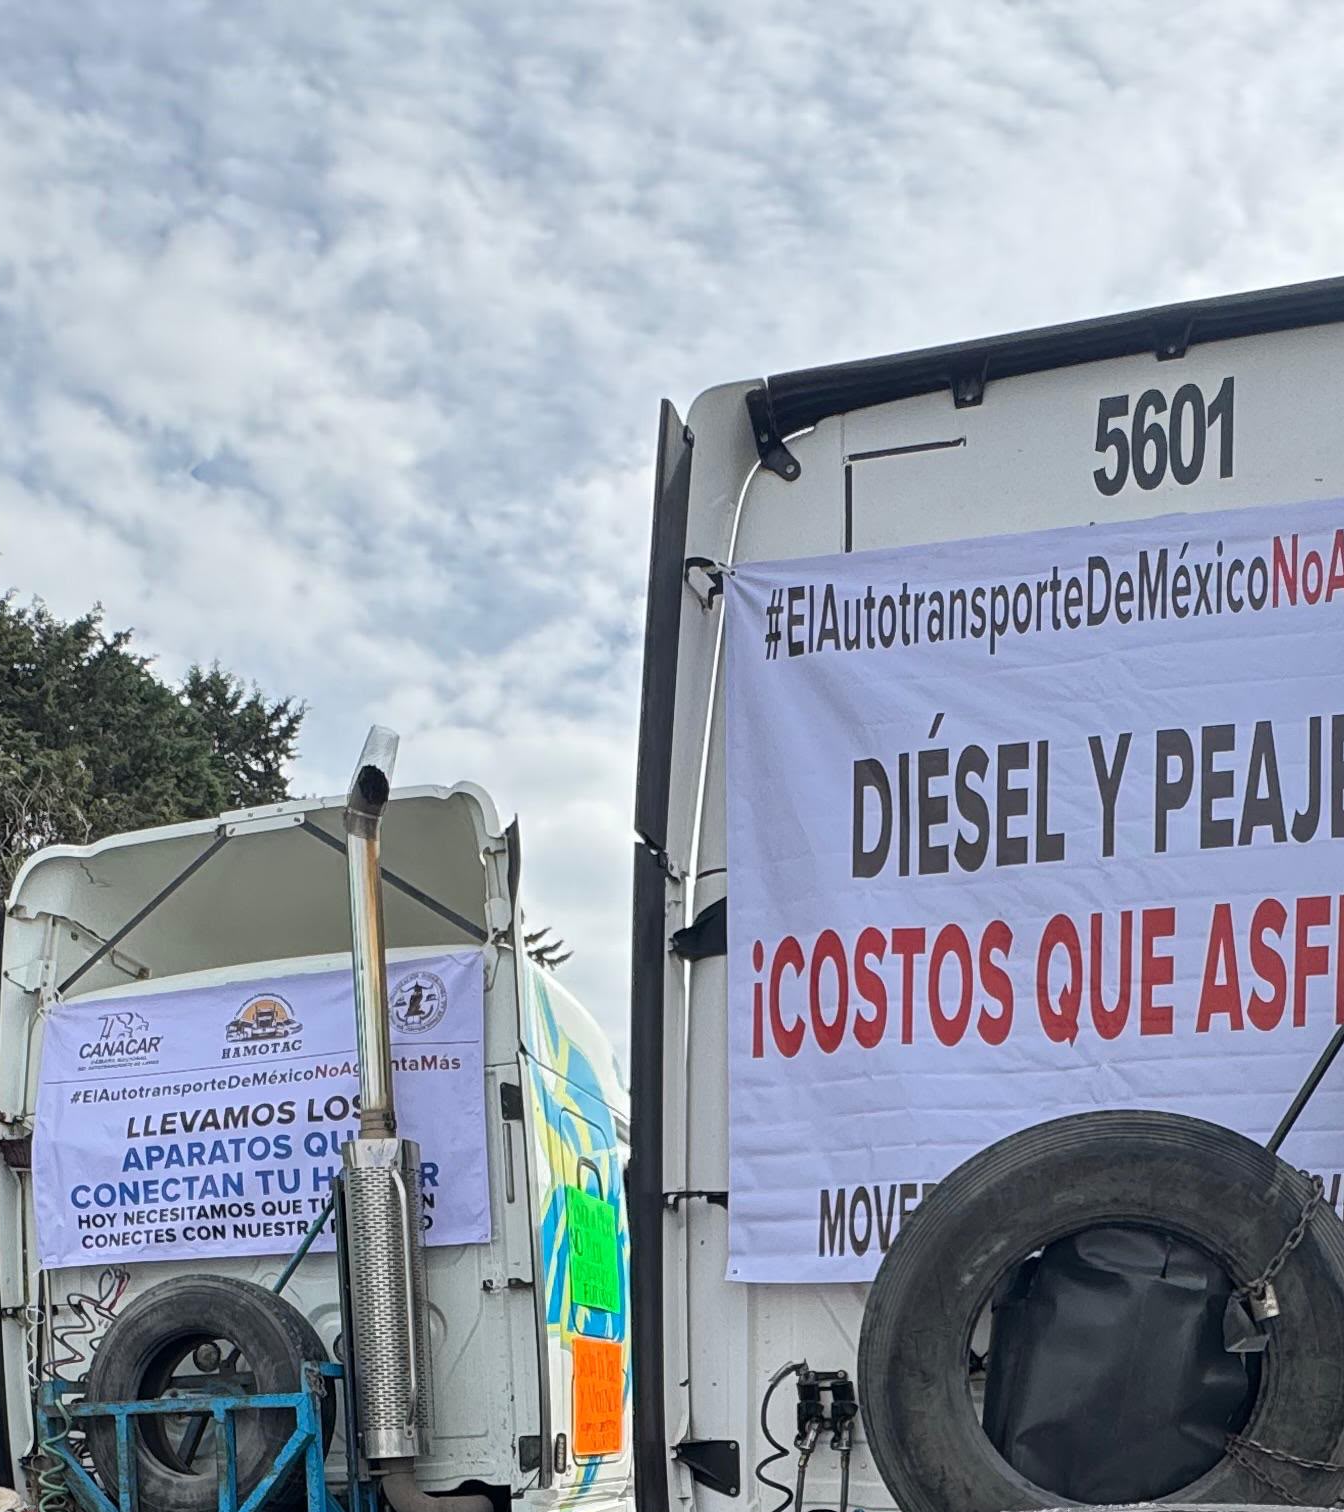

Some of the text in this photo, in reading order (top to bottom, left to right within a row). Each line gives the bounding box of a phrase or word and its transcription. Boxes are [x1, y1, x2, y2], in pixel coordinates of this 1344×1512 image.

[1093, 376, 1235, 496] 5601
[851, 712, 1066, 879] DIÉSEL
[1087, 732, 1133, 858] Y
[752, 918, 1014, 1059] ¡COSTOS
[1036, 906, 1176, 1047] QUE
[79, 1036, 161, 1059] CANACAR
[70, 1053, 461, 1104] #ElAutotransporteDeMéxicoNoAgntaMás
[126, 1100, 296, 1139] LLEVAMOS
[122, 1130, 354, 1172] APARATOS QU
[70, 1172, 244, 1209] CONECTAN
[255, 1168, 301, 1196] TU
[78, 1212, 118, 1230] HOY
[123, 1202, 256, 1226] NECESITAMOS
[261, 1199, 302, 1217] QUE
[819, 1182, 940, 1258] MOVE
[81, 1228, 177, 1249] CONECTES
[182, 1225, 226, 1242] CON
